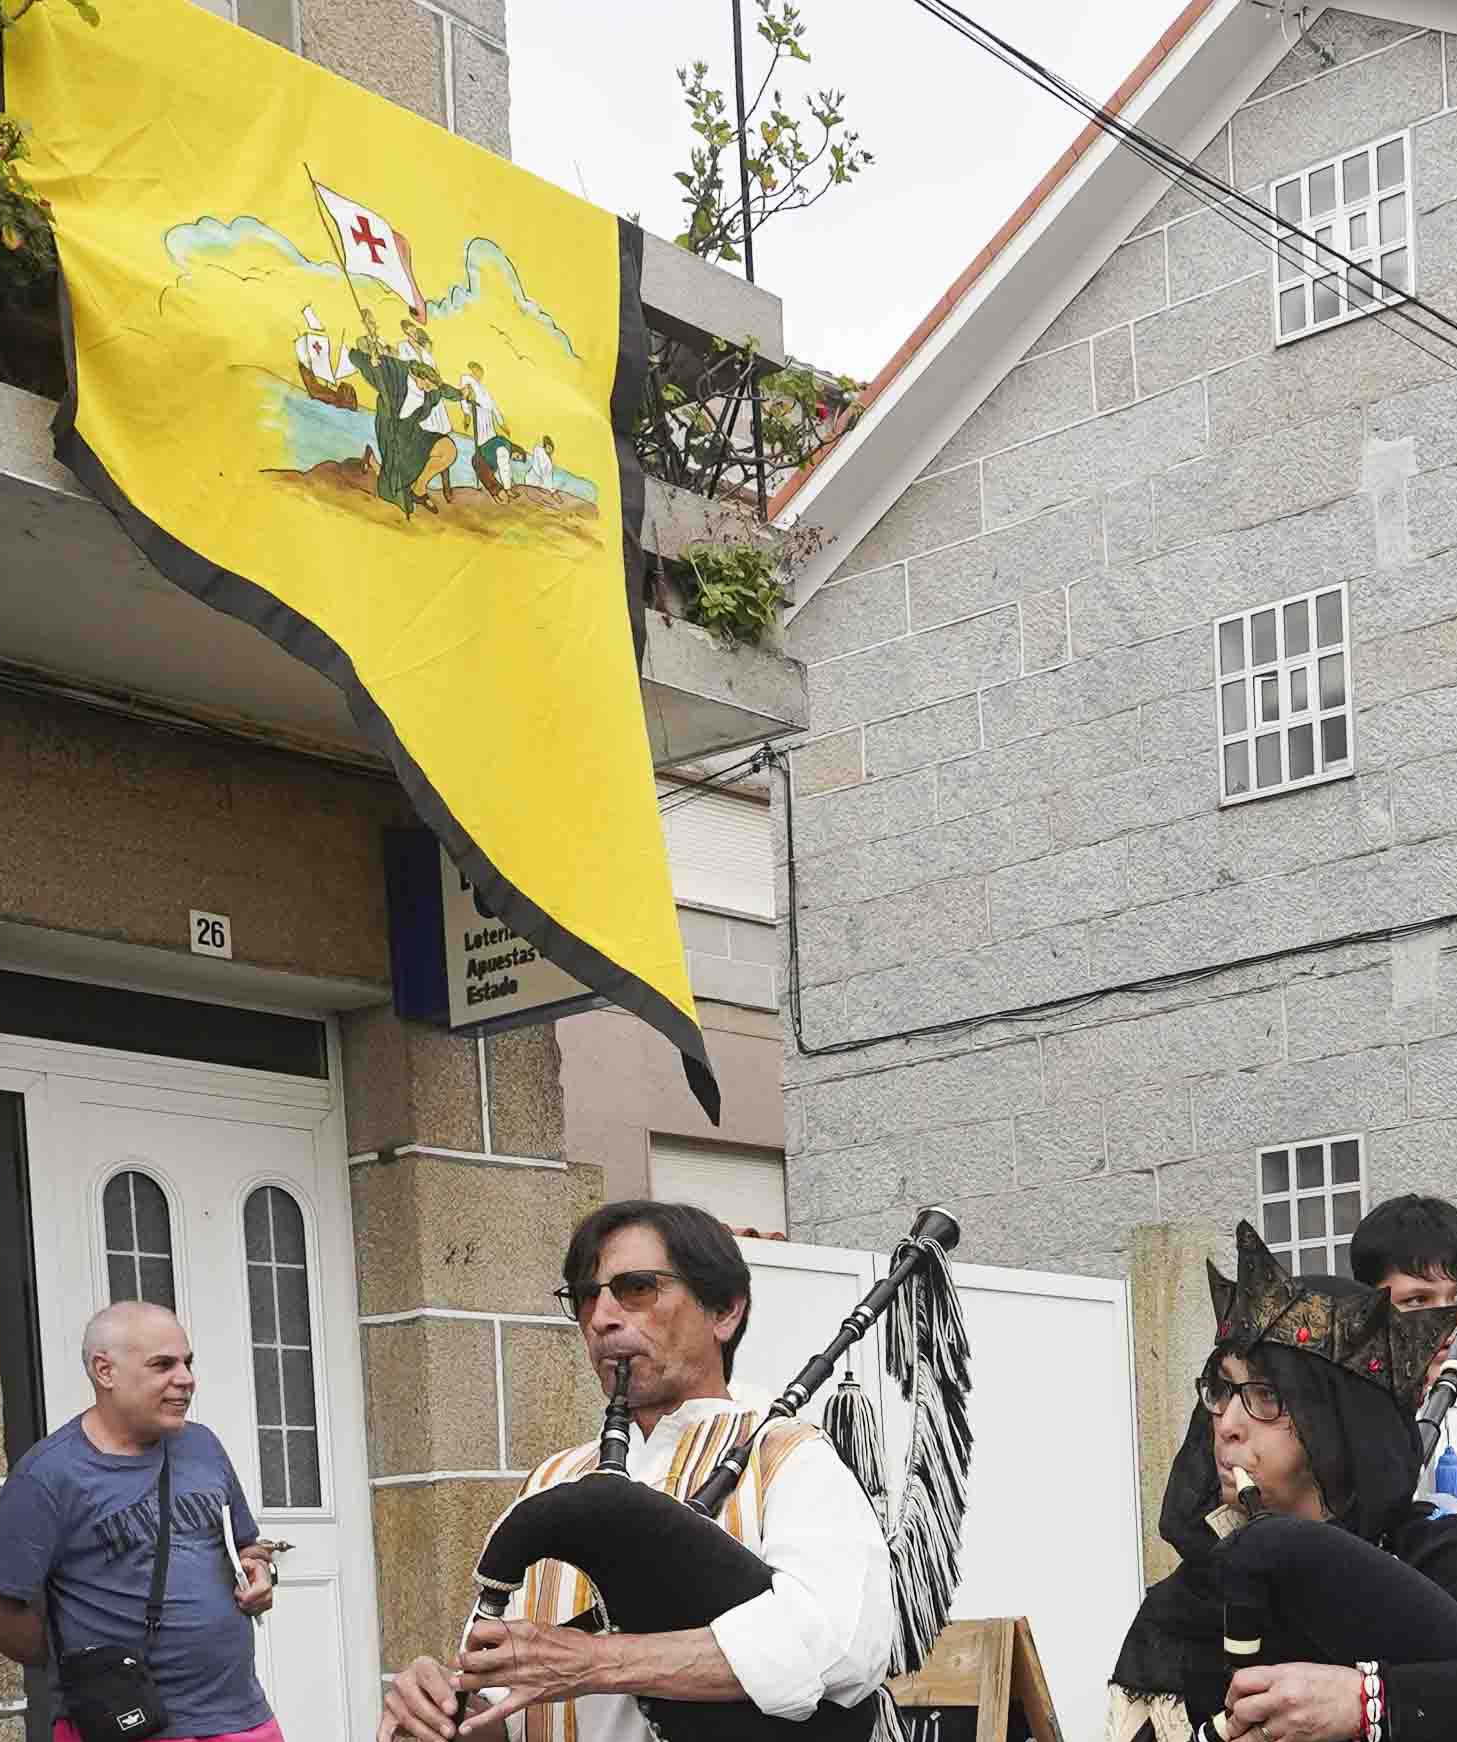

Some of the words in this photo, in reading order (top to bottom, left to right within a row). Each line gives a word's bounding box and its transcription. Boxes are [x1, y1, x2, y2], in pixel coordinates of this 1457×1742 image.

[197, 918, 225, 948] 26
[466, 946, 536, 980] Apuestas
[467, 976, 518, 1006] Estado
